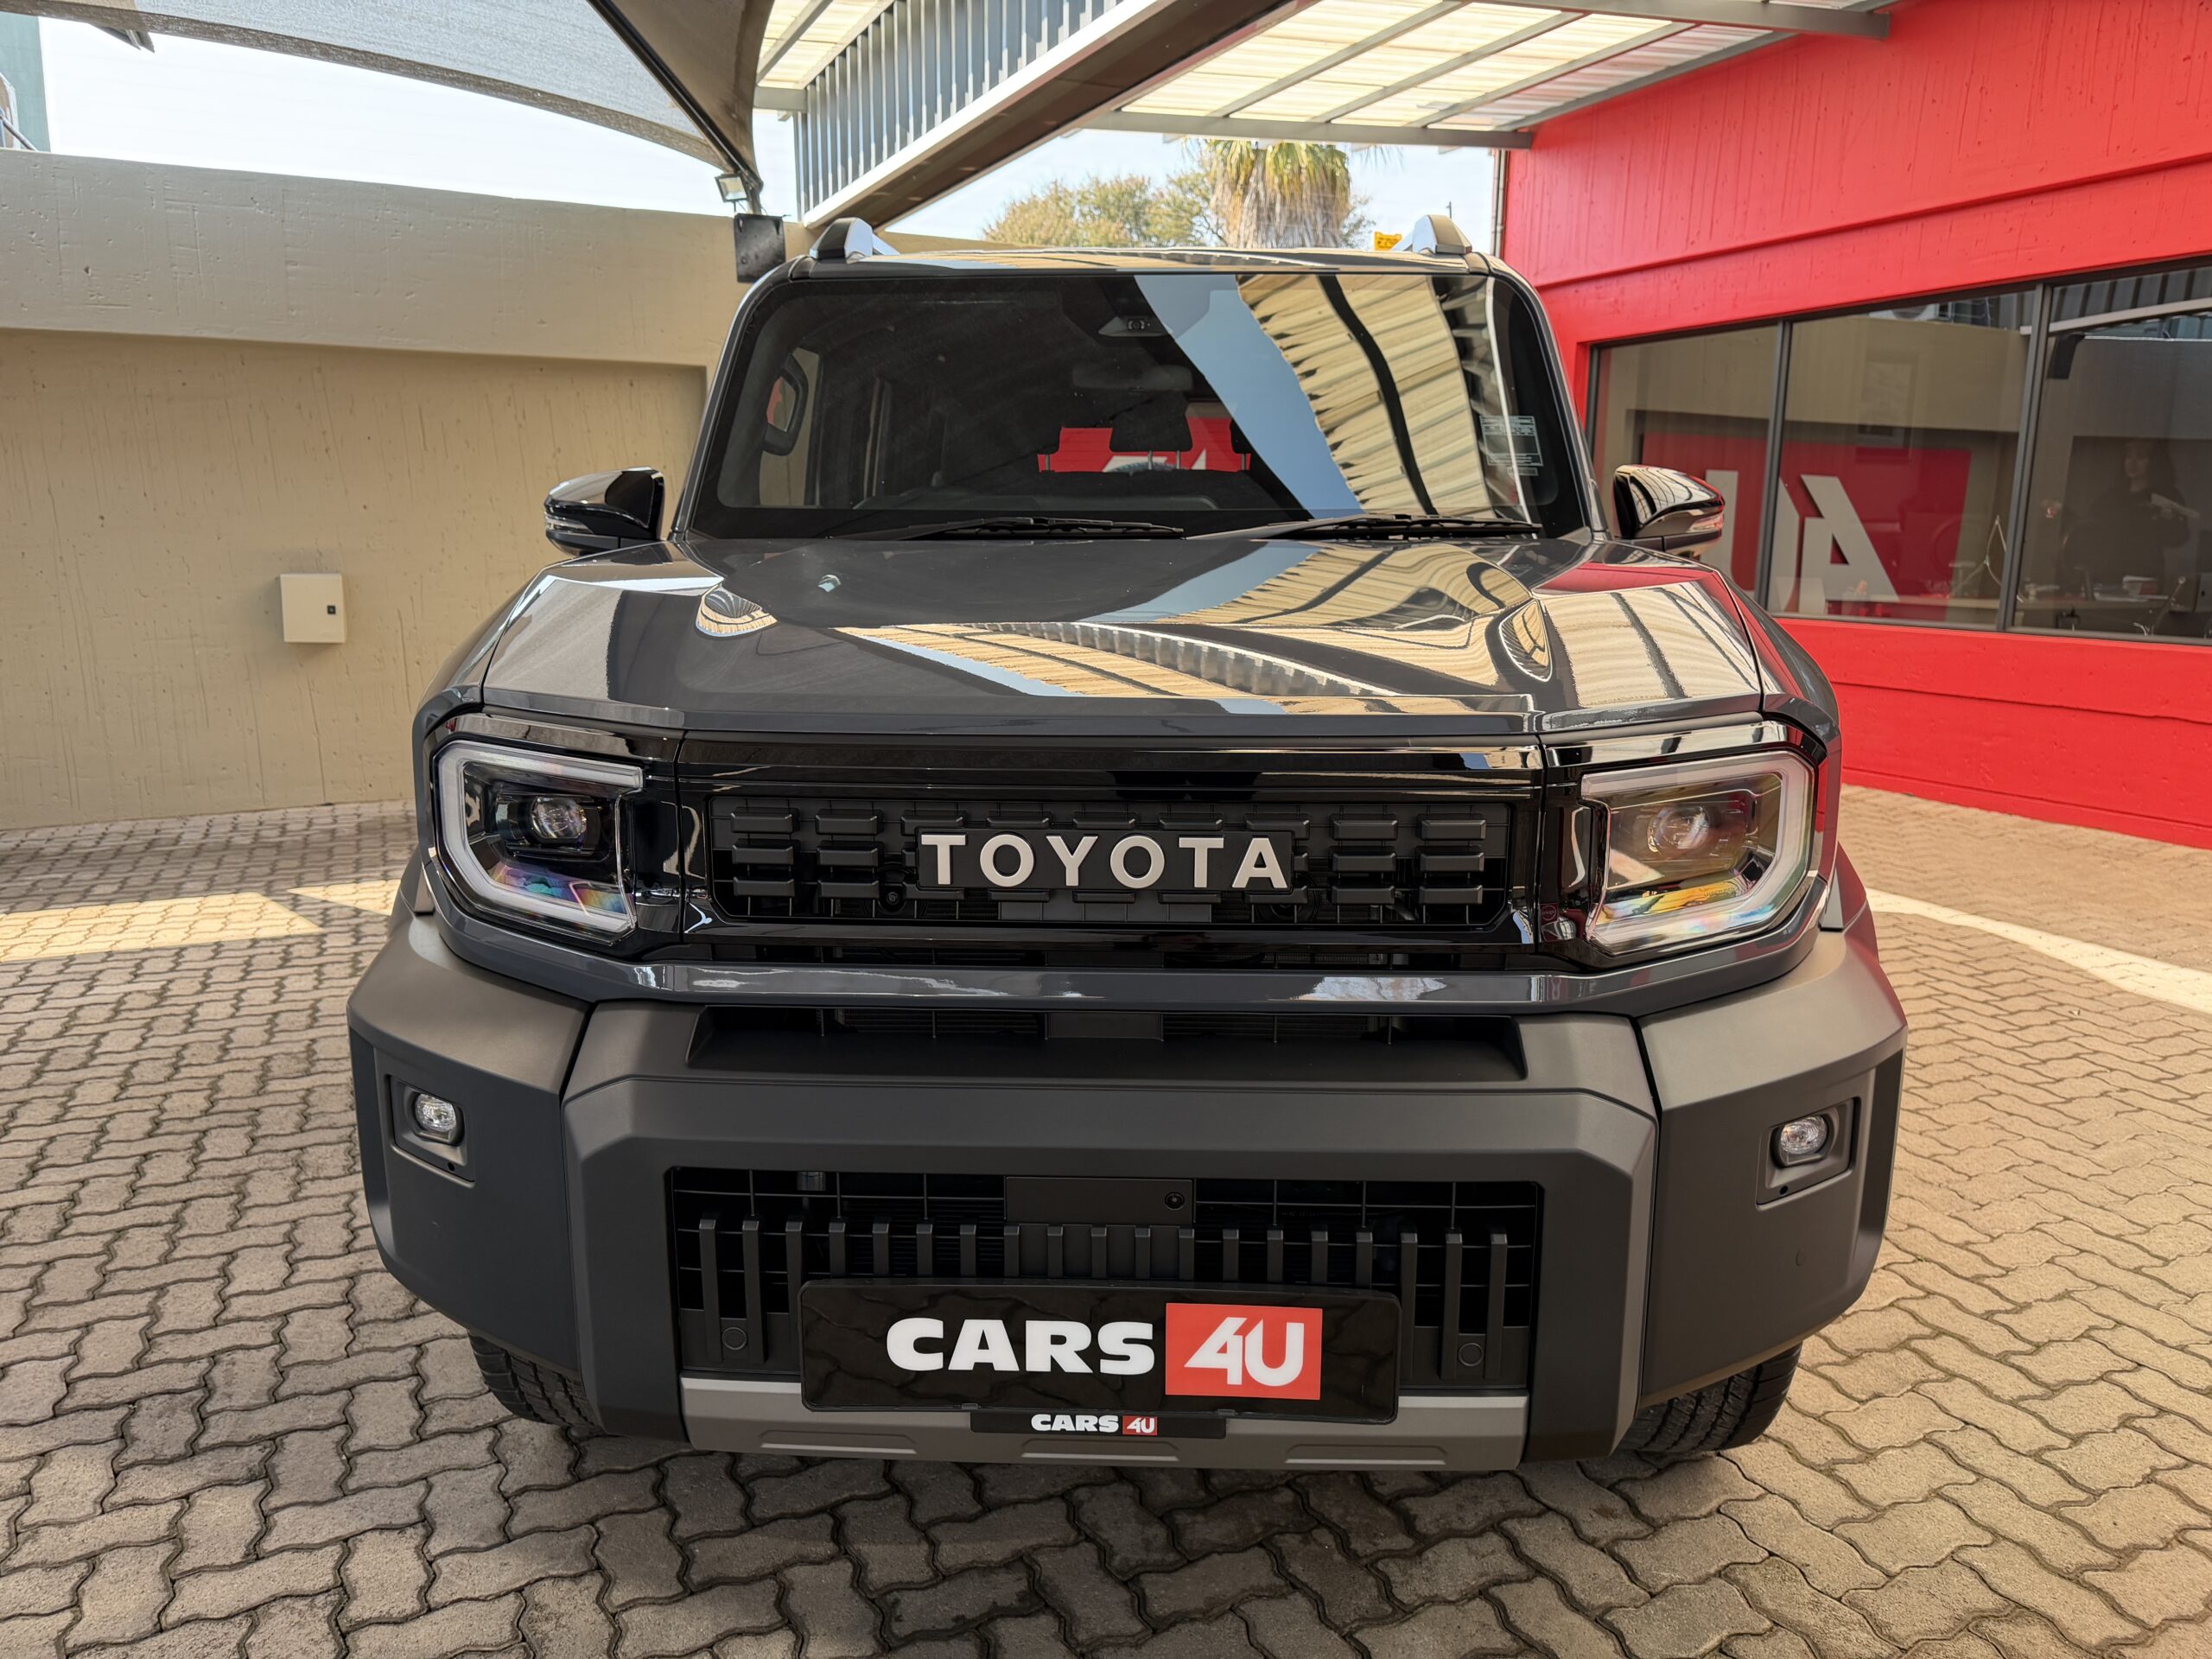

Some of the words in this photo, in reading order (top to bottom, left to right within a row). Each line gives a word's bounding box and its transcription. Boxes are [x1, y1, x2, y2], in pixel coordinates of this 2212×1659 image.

[920, 833, 1289, 890] TOYOTA
[887, 1316, 1156, 1376] CARS
[1184, 1316, 1306, 1387] 4U
[1031, 1414, 1120, 1433] CARS
[1126, 1416, 1156, 1434] 4U
